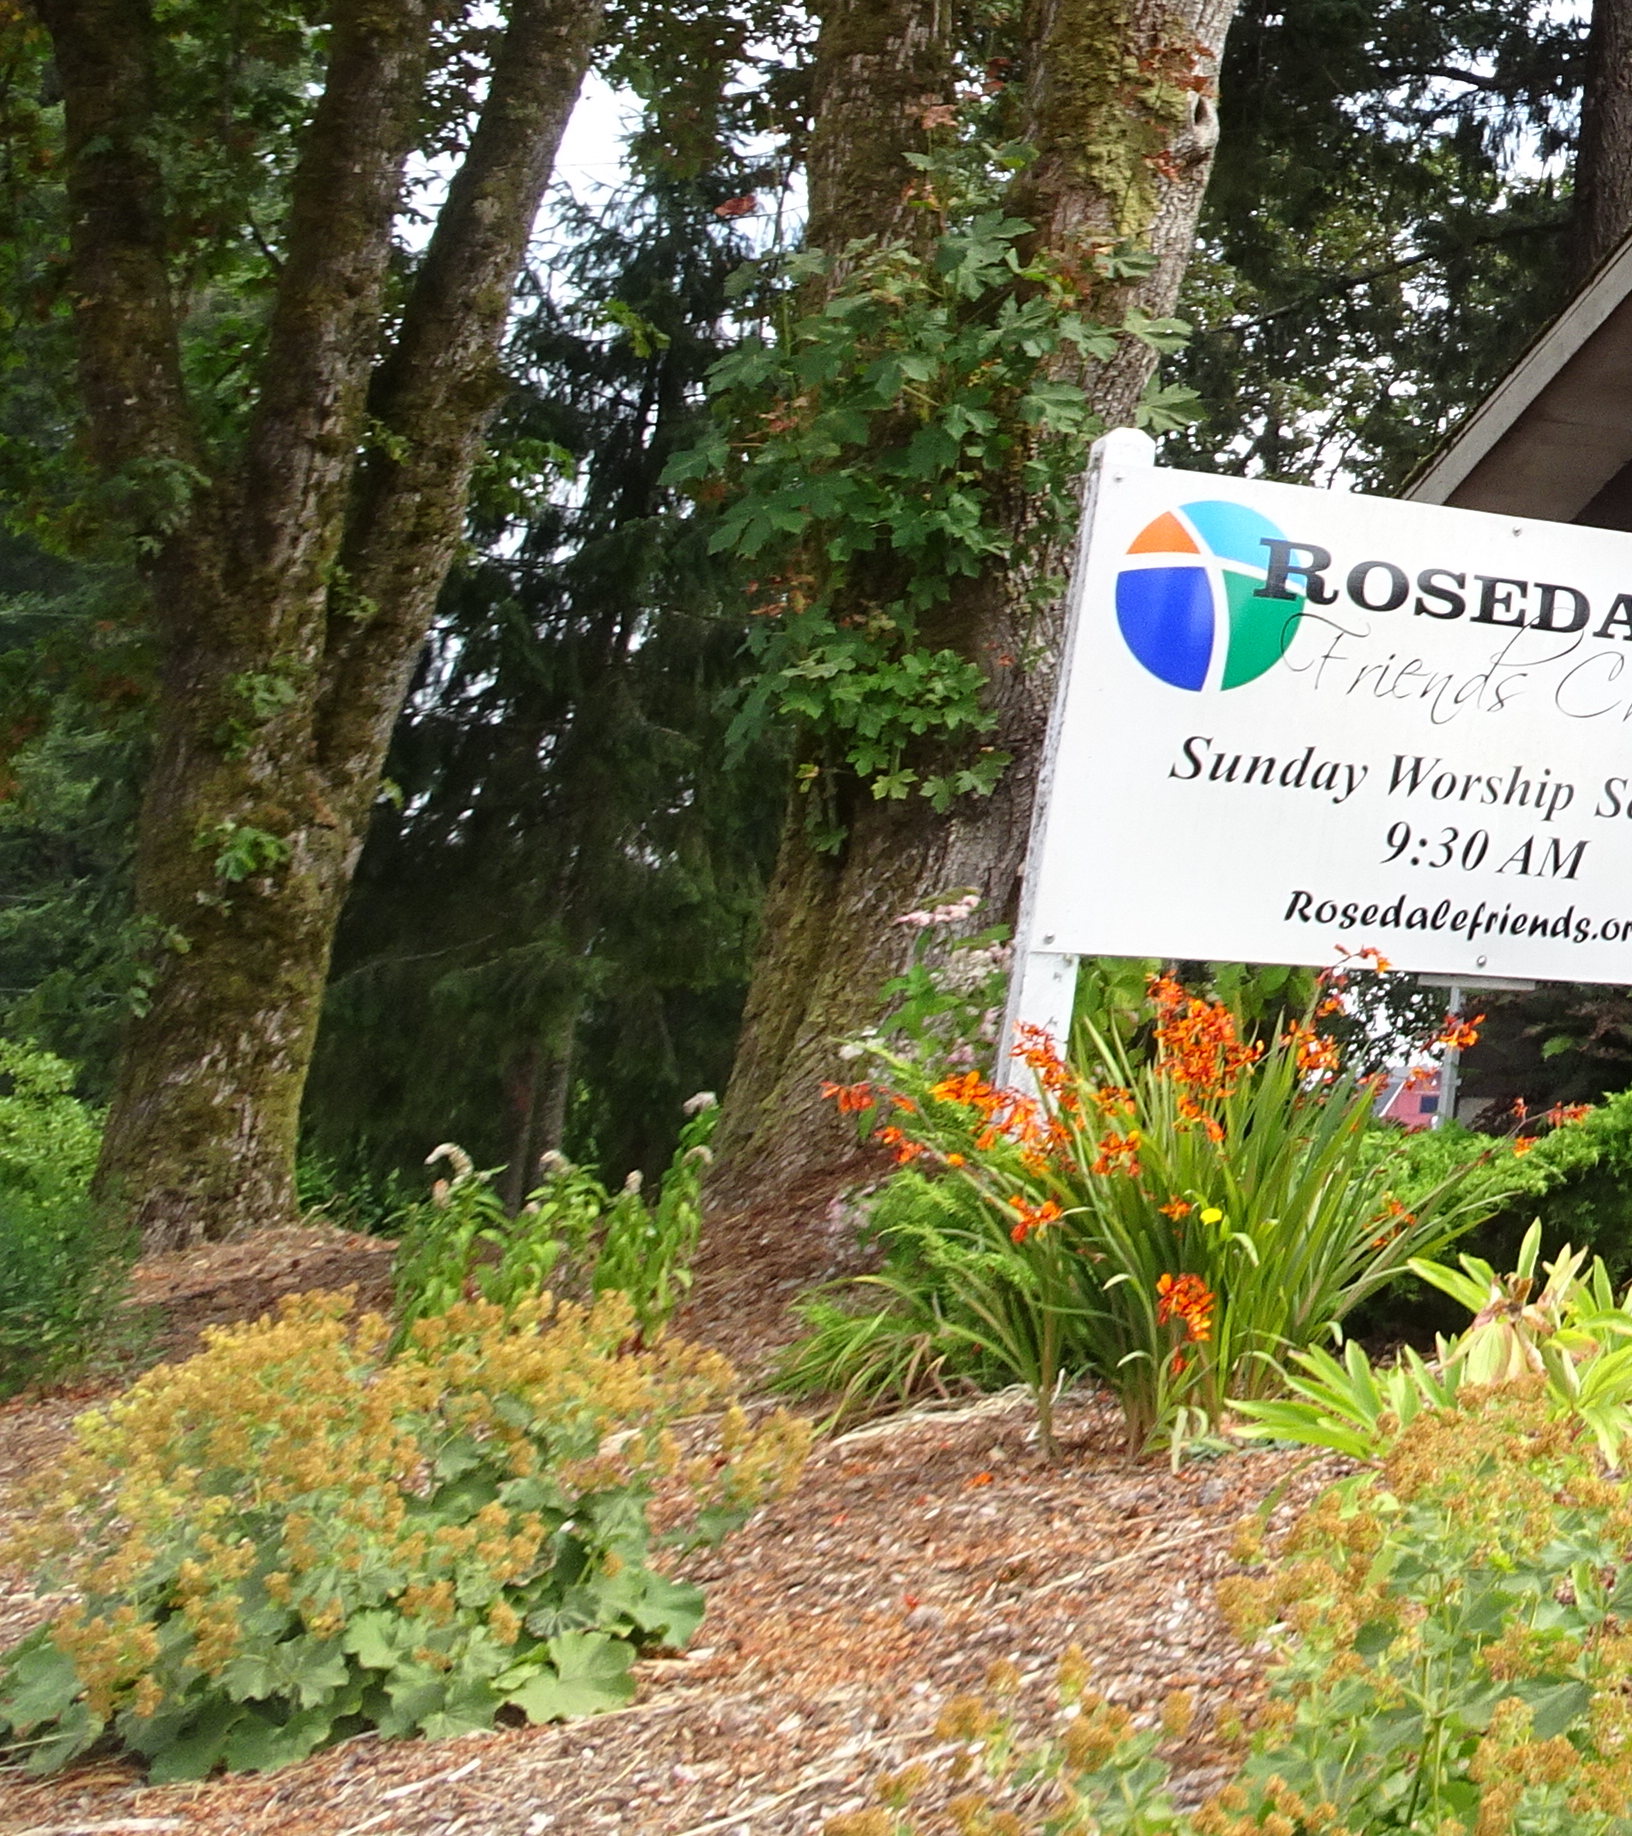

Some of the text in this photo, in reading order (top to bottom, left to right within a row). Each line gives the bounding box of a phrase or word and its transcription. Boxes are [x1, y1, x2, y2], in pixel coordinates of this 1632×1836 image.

[1280, 608, 1584, 725] Friends
[1169, 735, 1368, 802] Sunday
[1388, 754, 1576, 822] Worship
[1379, 820, 1590, 881] 9:30 AM
